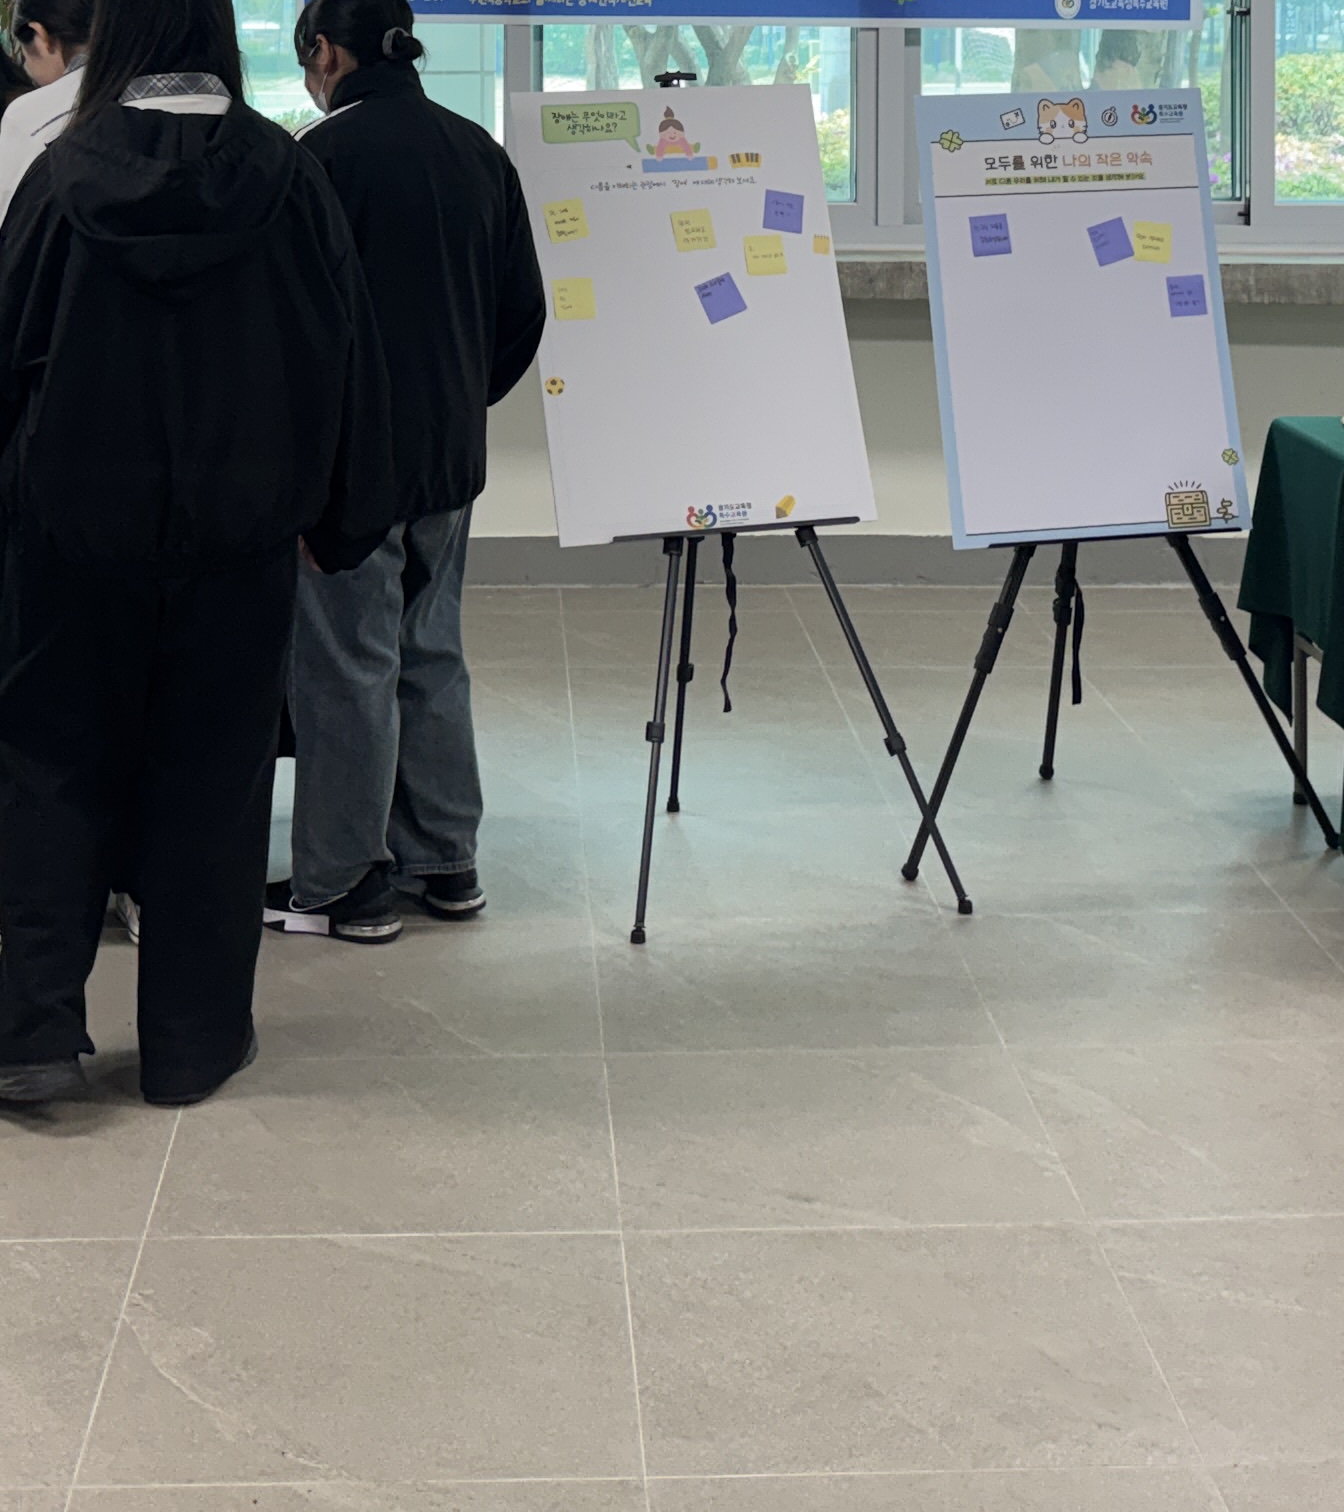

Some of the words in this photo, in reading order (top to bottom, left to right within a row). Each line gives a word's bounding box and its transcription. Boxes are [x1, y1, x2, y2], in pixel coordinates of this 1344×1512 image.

[551, 110, 580, 124] 장애는
[984, 155, 1026, 171] 모두를
[1030, 154, 1058, 170] 위한
[1062, 153, 1092, 168] 나의
[1096, 151, 1123, 167] 작은
